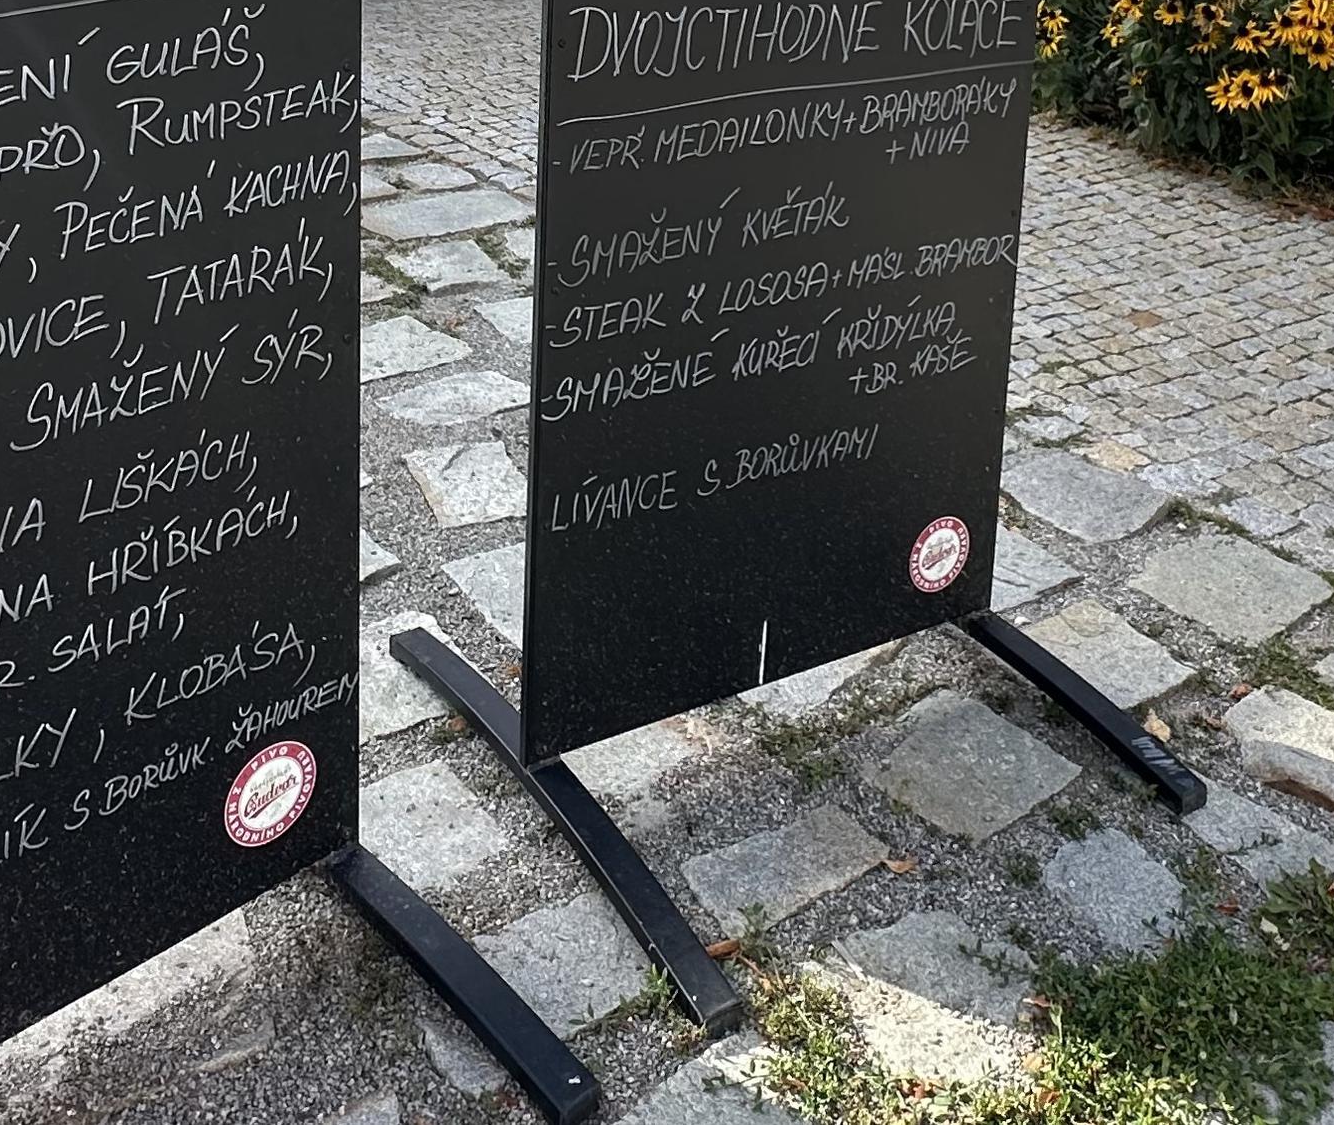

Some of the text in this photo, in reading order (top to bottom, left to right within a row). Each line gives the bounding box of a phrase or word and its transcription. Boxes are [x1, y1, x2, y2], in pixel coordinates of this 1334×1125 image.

[106, 3, 266, 92] GULÁŠ,
[116, 71, 359, 156] RUMPSTEAK,
[54, 159, 215, 261] PEČENÁ
[224, 149, 358, 217] KACHNA,
[742, 181, 850, 247] KVĚTÁK
[147, 217, 334, 325] TATARÁK,
[681, 283, 708, 325] Z
[10, 323, 241, 451] SMAŽENÝ
[241, 308, 334, 386] SÝR,
[731, 308, 843, 382] KUŘECÍ
[909, 328, 978, 377] KAŠE
[78, 428, 258, 524] LIŠKÁCH,
[551, 423, 879, 533] LÍVANCE S BORŮVKAMI
[86, 485, 299, 596] HŘÍBKÁCH,
[48, 585, 187, 674] SALÁT,
[123, 620, 317, 726] KLOBÁSA,
[250, 746, 288, 770] PIVO
[289, 750, 313, 819] PIVOVARU
[64, 789, 92, 831] S
